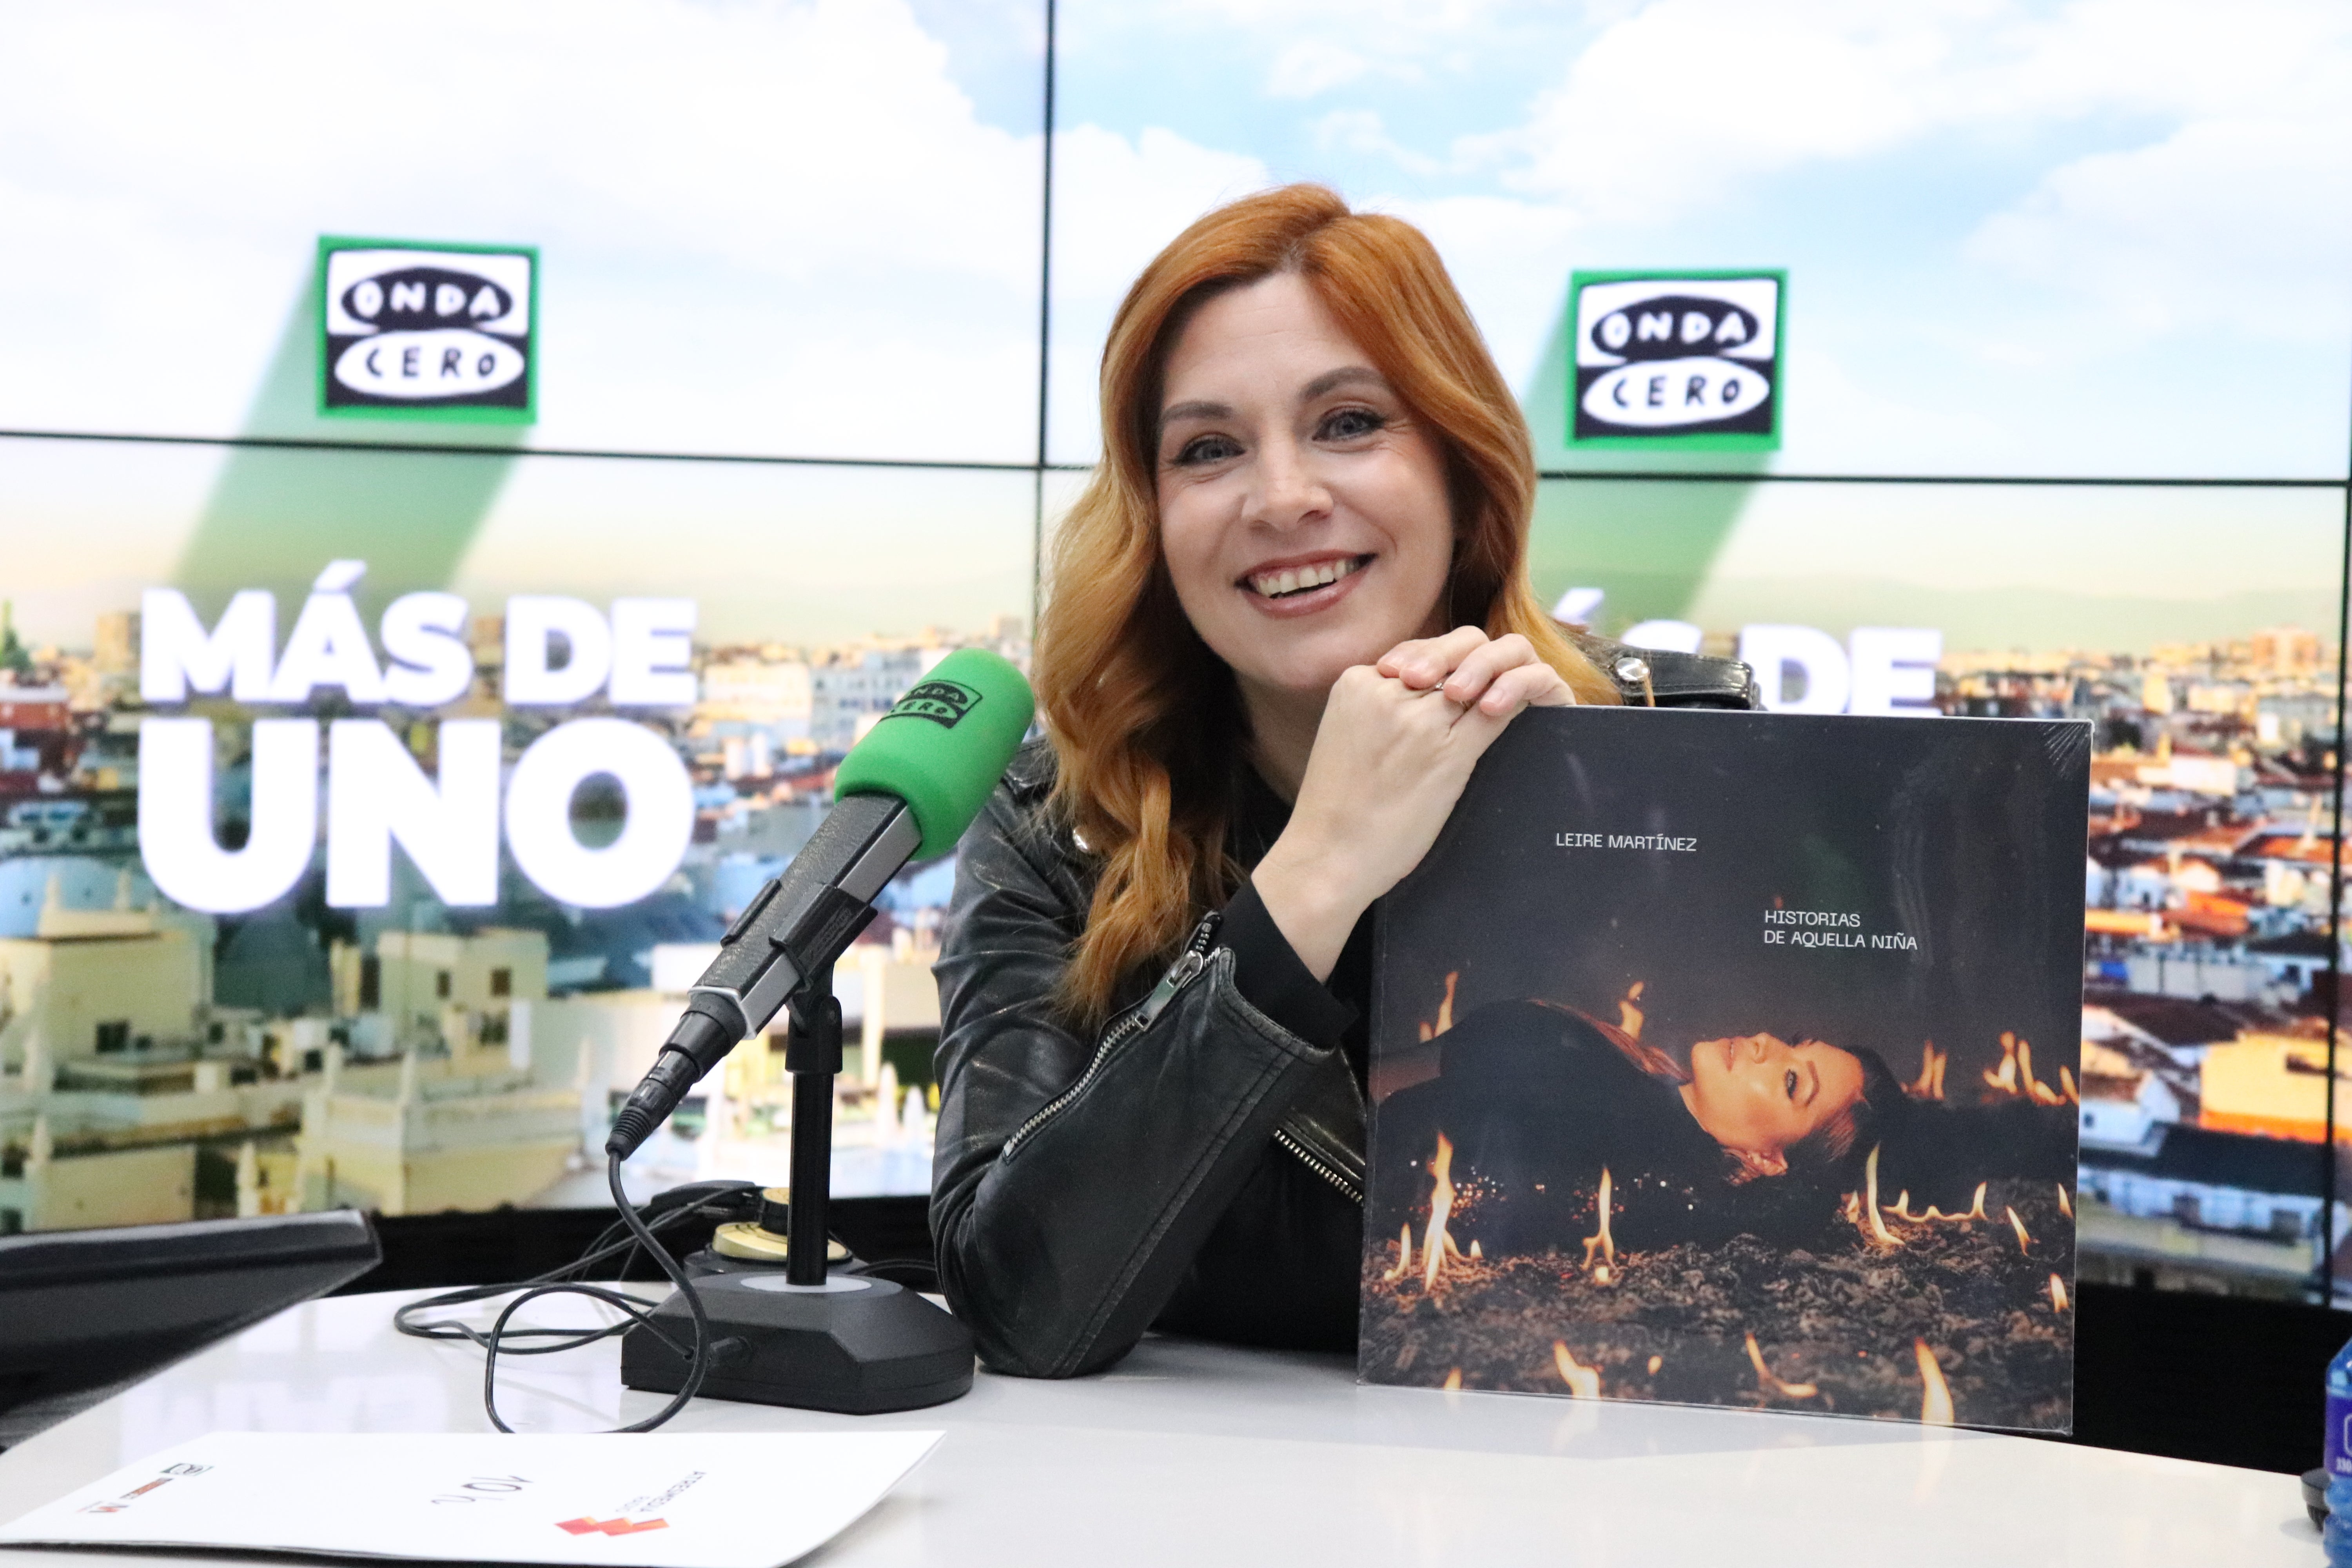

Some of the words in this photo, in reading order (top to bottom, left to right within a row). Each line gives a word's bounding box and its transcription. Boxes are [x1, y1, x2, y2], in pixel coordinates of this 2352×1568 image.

[354, 279, 501, 318] ONDA
[1601, 311, 1748, 349] ONDA
[365, 346, 497, 378] CERO
[1612, 374, 1742, 408] CERO
[139, 559, 474, 705] MÁS
[504, 595, 697, 705] DE
[1738, 624, 1942, 717] DE
[138, 716, 695, 914] UNO
[1556, 833, 1603, 848] LEIRE
[1609, 833, 1698, 852] MARTÍNEZ
[1765, 910, 1861, 928] HISTORIAS
[1764, 929, 1786, 945] DE
[1791, 931, 1866, 949] AQUELLA
[1872, 932, 1918, 951] NIÑA
